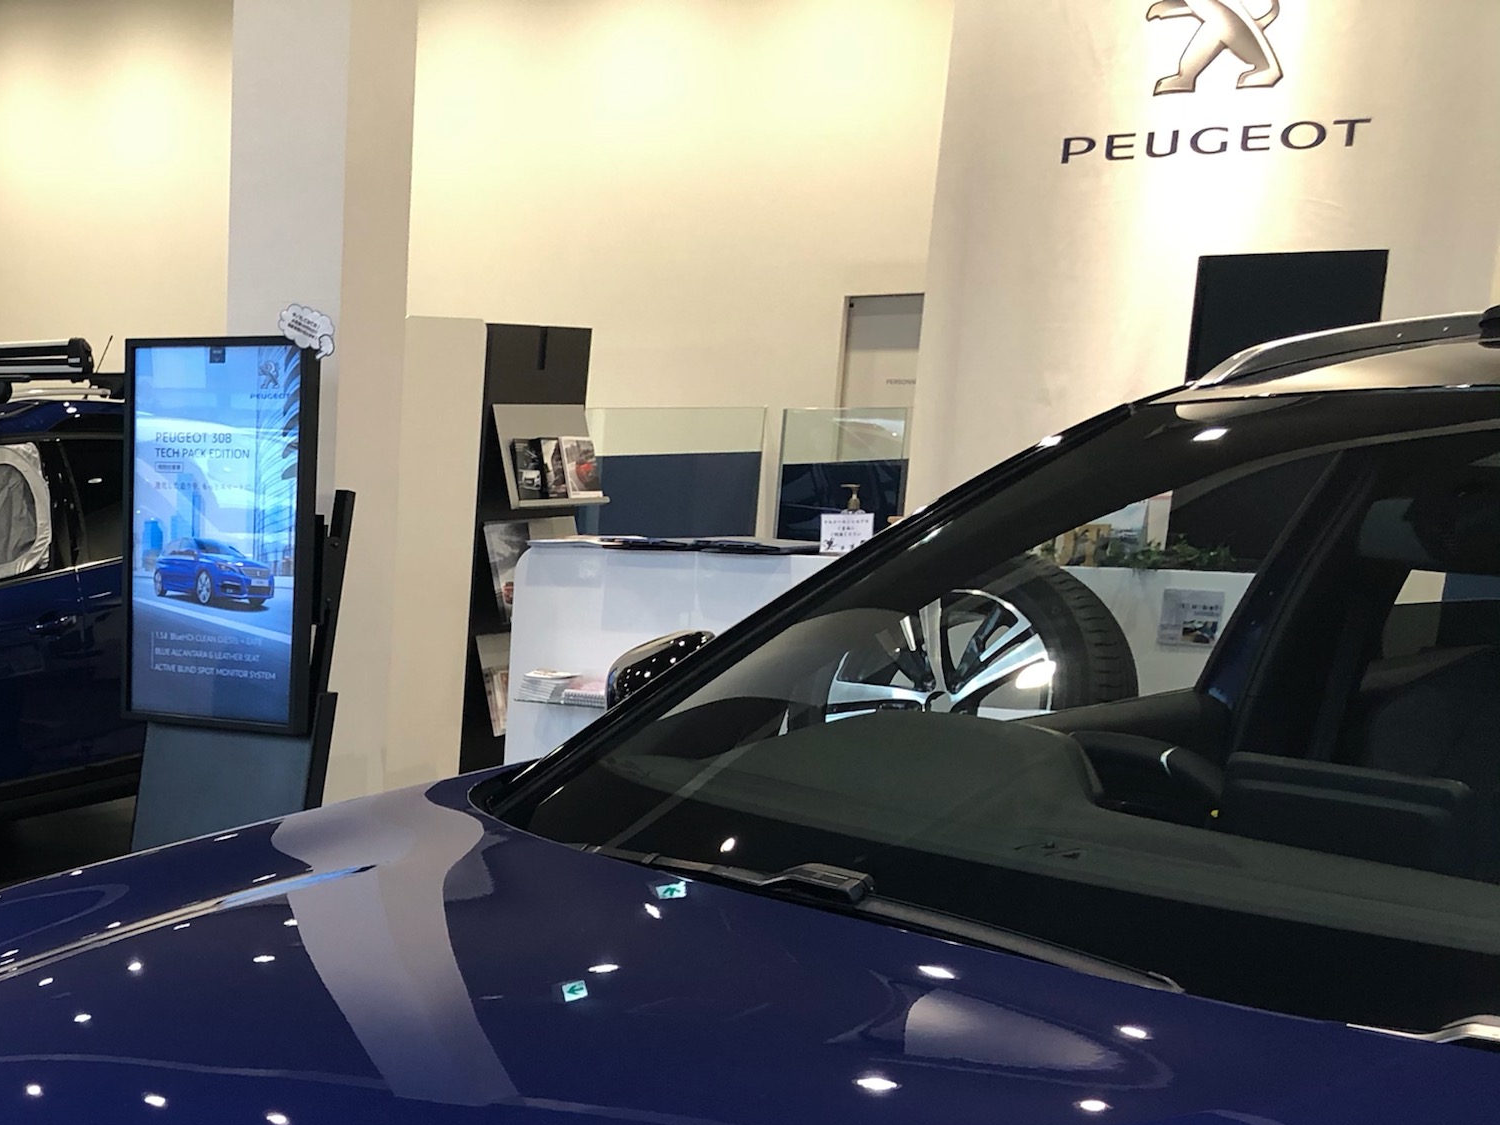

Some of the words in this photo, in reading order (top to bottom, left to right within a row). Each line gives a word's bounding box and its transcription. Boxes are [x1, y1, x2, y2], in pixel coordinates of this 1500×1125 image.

[1060, 117, 1373, 165] PEUGEOT
[250, 392, 290, 400] PEUGEOT
[155, 431, 209, 444] PEUGEOT
[211, 432, 233, 444] 308
[155, 447, 180, 459] TECH
[181, 448, 207, 459] PACK
[208, 448, 251, 460] EDITION
[214, 651, 243, 662] LEATHER
[244, 653, 260, 663] SEAT
[154, 663, 176, 673] ACTIVE
[177, 664, 197, 675] BLIND
[197, 666, 215, 676] SPOT
[216, 667, 248, 679] MONITOR
[249, 669, 277, 681] SYSTEM
